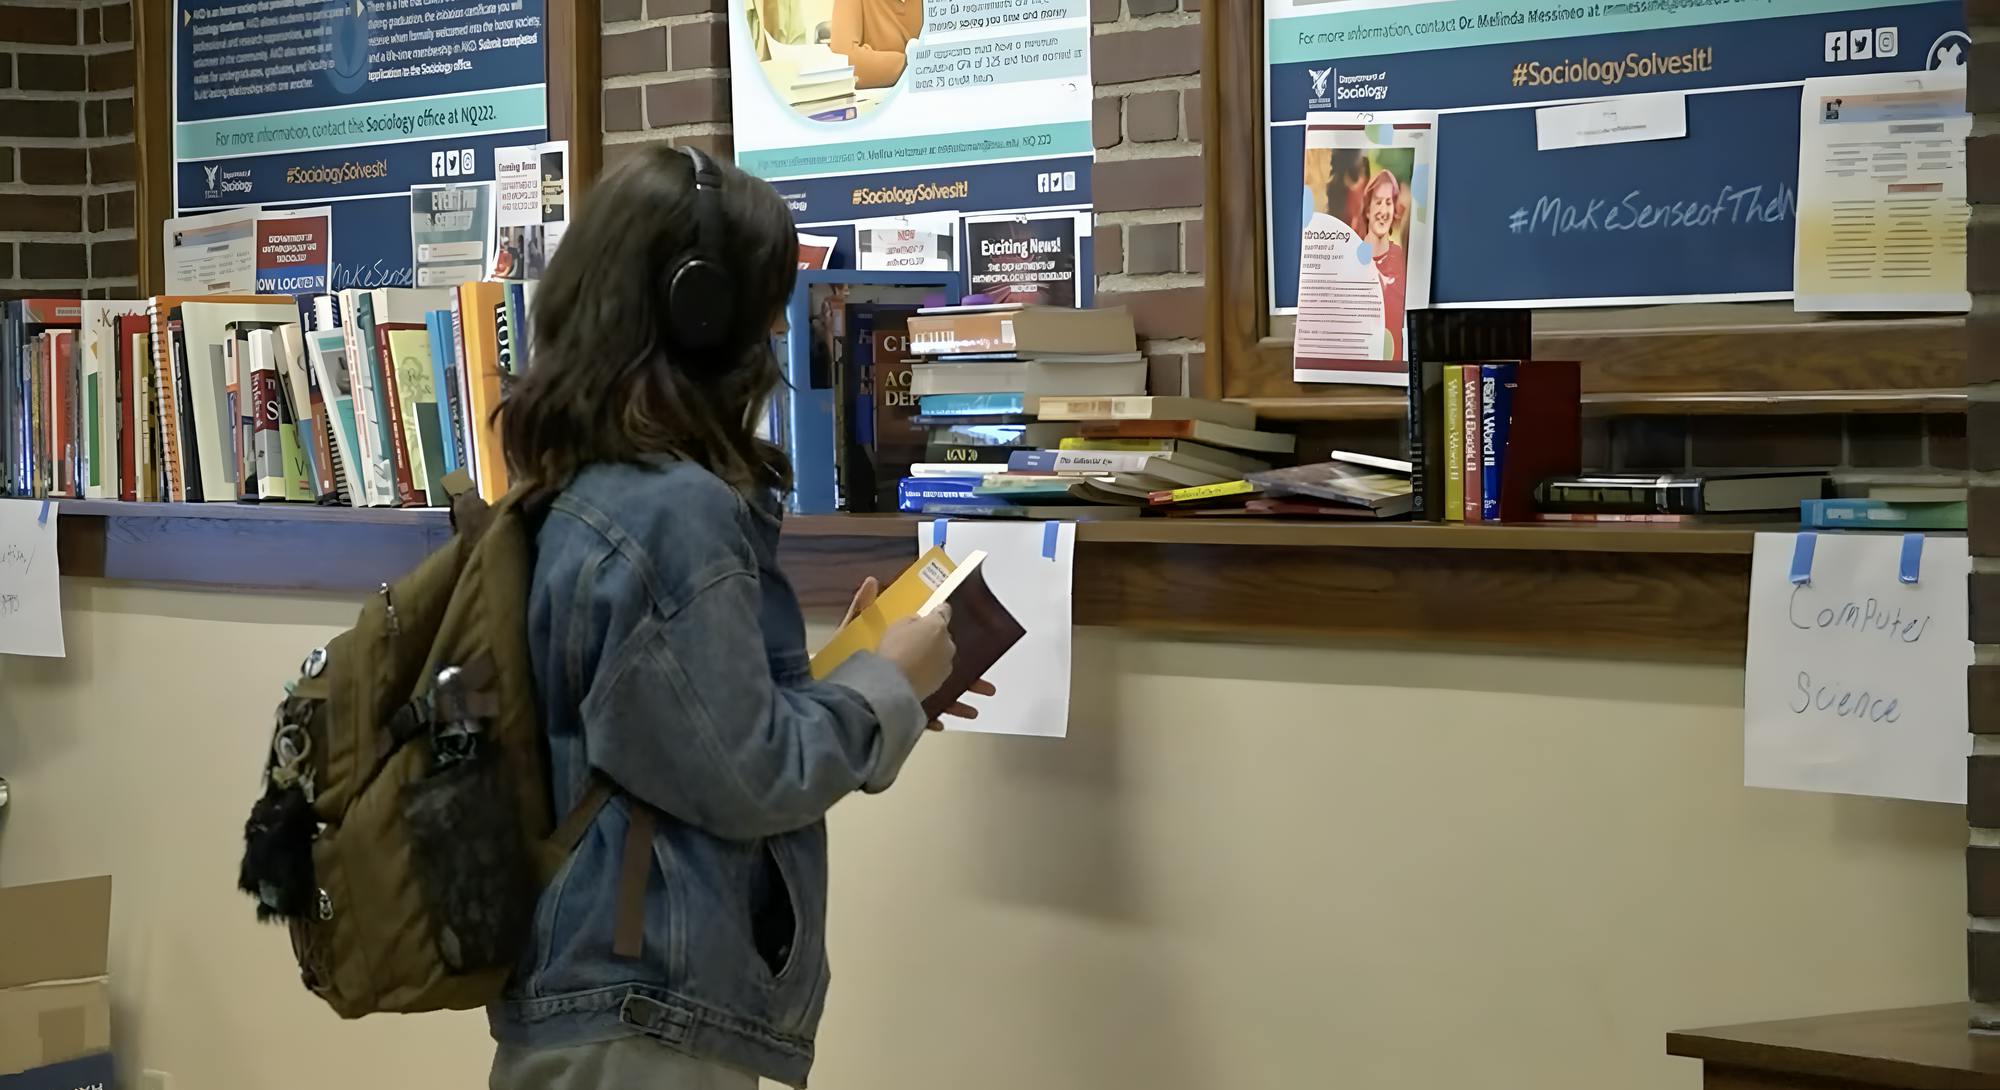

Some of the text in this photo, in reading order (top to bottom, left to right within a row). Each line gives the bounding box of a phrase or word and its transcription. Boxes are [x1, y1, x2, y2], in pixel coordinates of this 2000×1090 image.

[1511, 46, 1713, 88] #SociologySolvesIt!
[1337, 85, 1388, 100] Sociology
[367, 113, 414, 134] Sociology
[418, 108, 445, 127] office
[448, 108, 458, 123] at
[981, 239, 1028, 258] Exciting
[1790, 671, 1901, 724] Science
